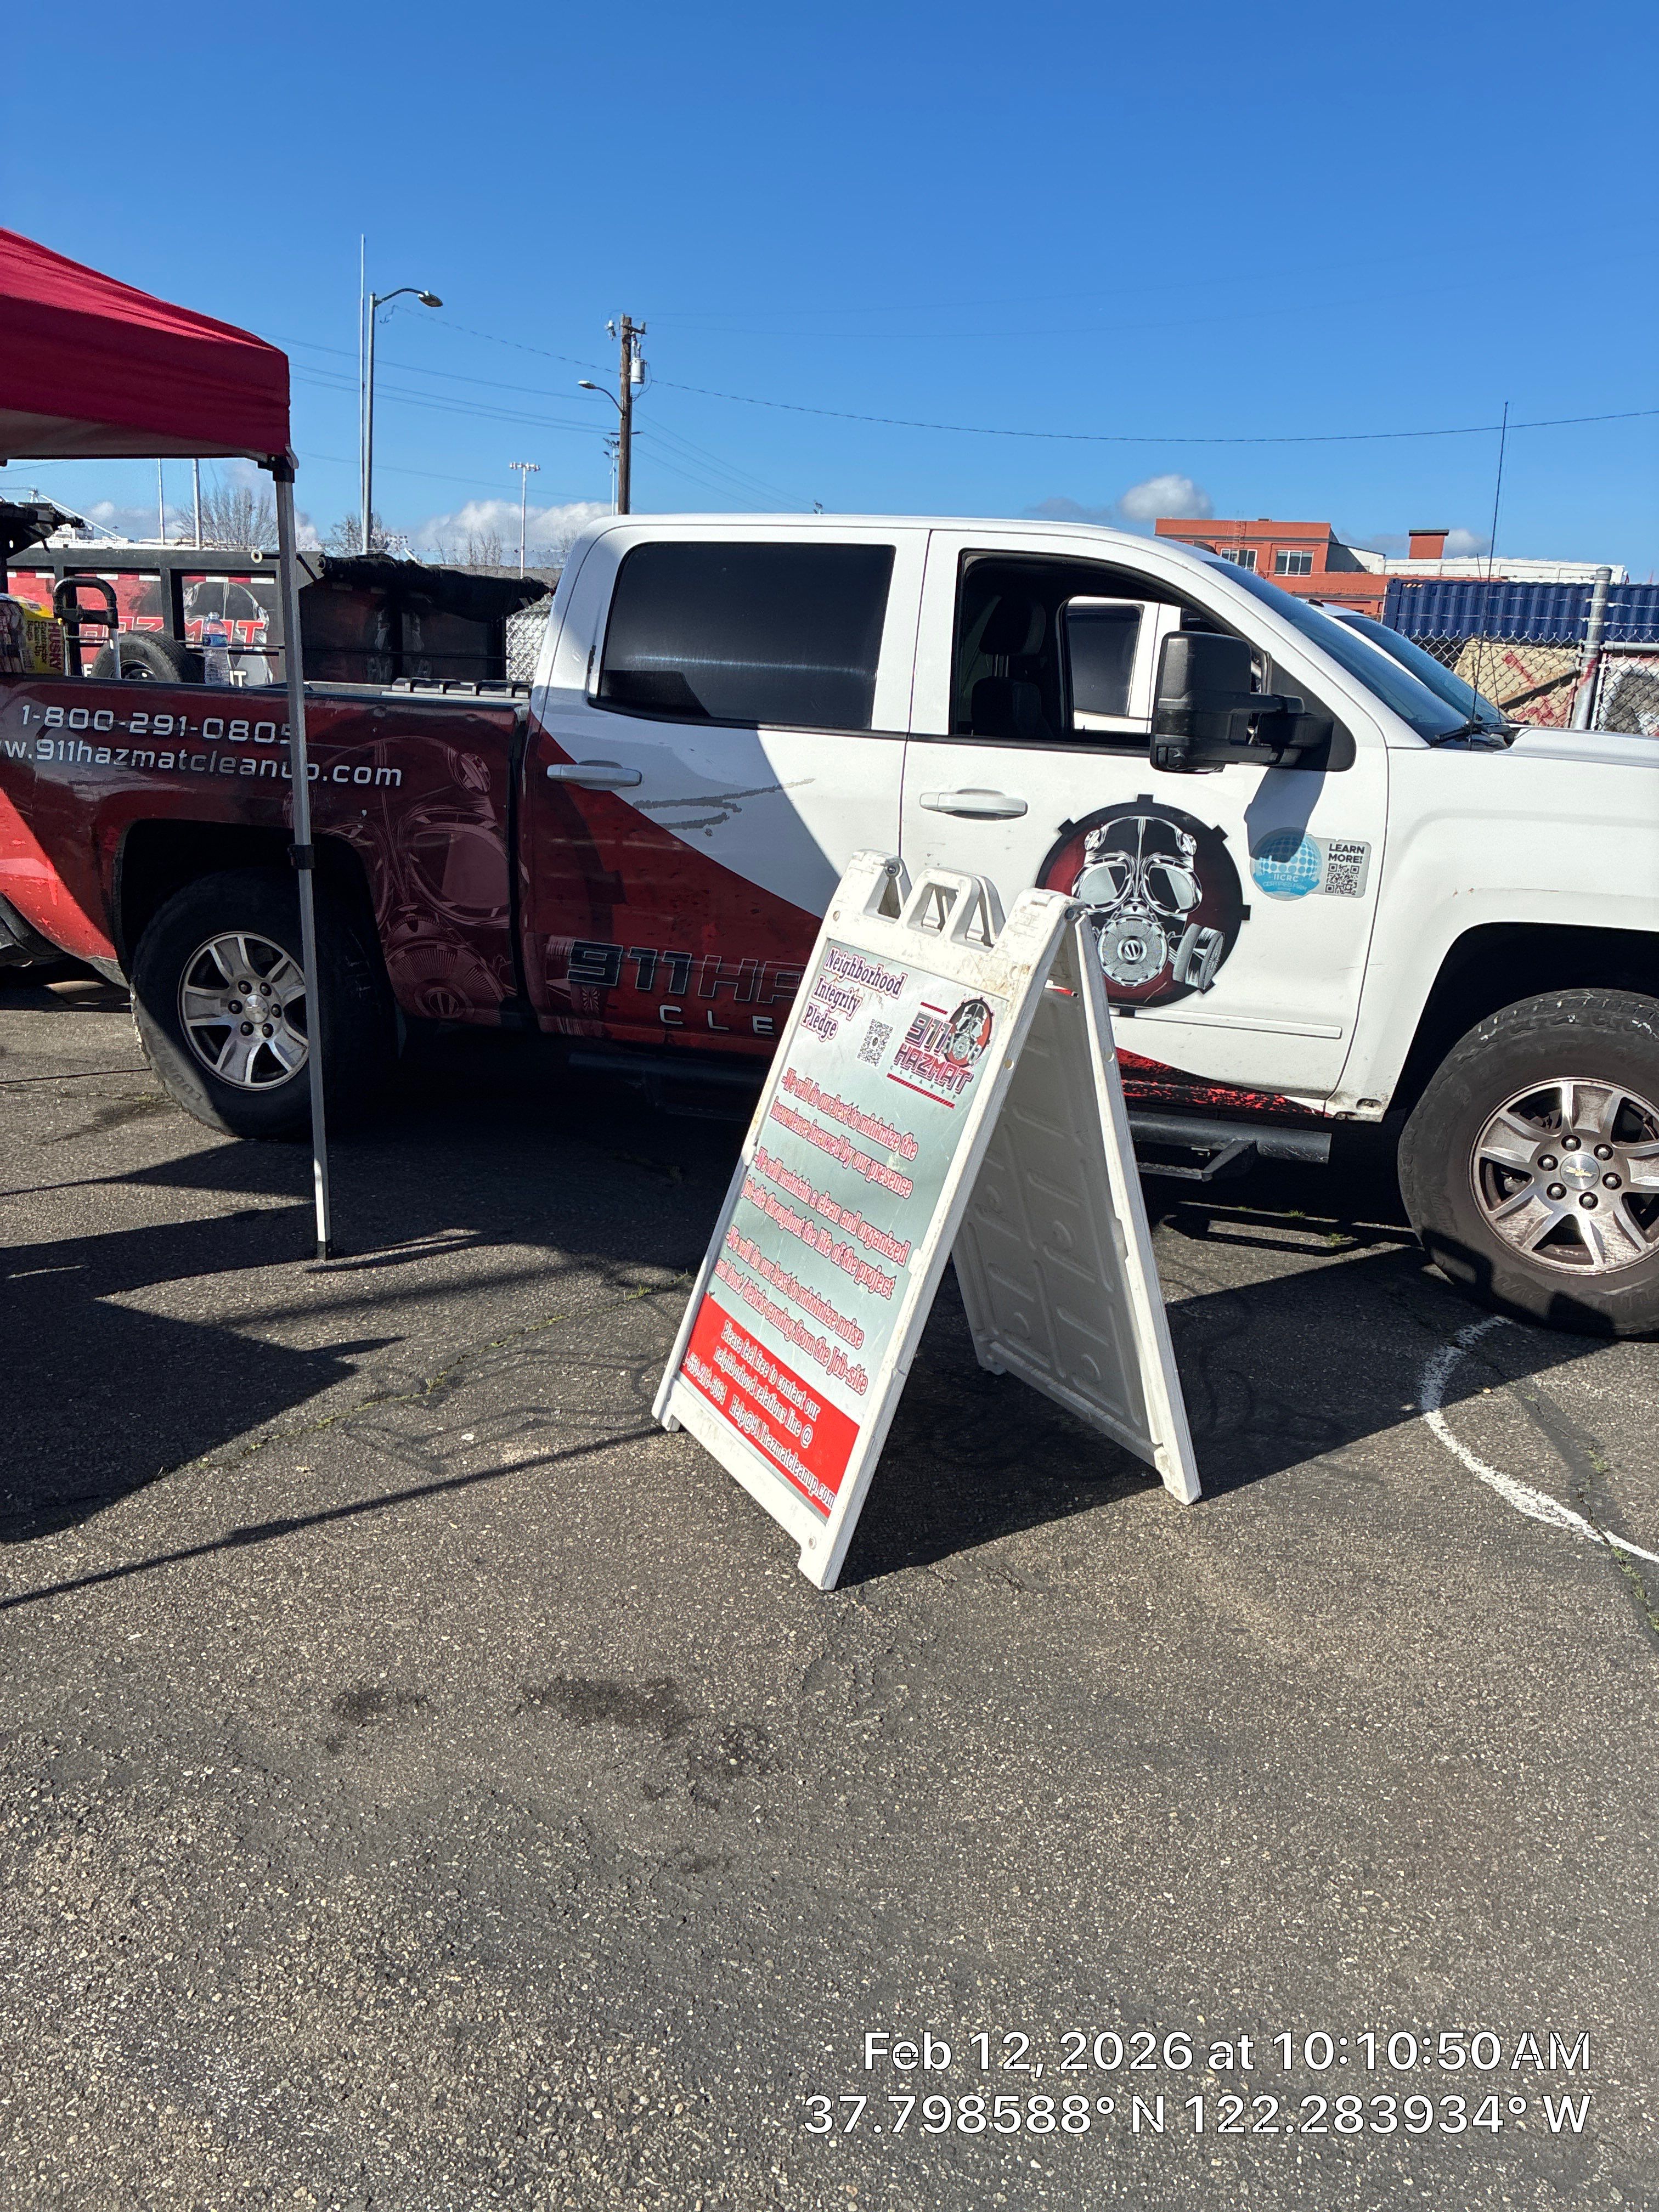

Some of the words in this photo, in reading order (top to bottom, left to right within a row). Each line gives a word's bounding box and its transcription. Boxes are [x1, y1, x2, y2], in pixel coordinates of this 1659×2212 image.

[48, 622, 63, 670] HUSKY
[0, 738, 403, 786] w.911hazmatcleanup.com
[1328, 853, 1363, 864] MORE!
[1329, 843, 1365, 855] LEARN
[1273, 873, 1300, 882] IICRC
[814, 975, 862, 1019] Integrity
[824, 946, 907, 997] Neighborhood
[800, 1004, 837, 1039] Pledge
[905, 1011, 953, 1056] 911
[894, 1043, 975, 1094] HAZMAT
[782, 1068, 797, 1092] -We
[793, 1077, 812, 1101] will
[807, 1083, 820, 1106] do
[817, 1093, 835, 1114] our
[829, 1094, 853, 1124] best
[847, 1105, 861, 1129] to
[857, 1115, 901, 1152] minimize
[898, 1132, 918, 1161] the
[806, 1122, 845, 1158] incurred
[838, 1137, 856, 1169] by
[852, 1151, 871, 1175] our
[865, 1159, 913, 1199] presence
[753, 1147, 768, 1171] -We
[764, 1158, 783, 1182] will
[777, 1168, 812, 1204] maintain
[809, 1190, 819, 1209] a
[815, 1191, 842, 1224] clean
[838, 1209, 862, 1236] and
[856, 1221, 910, 1266] organized
[741, 1178, 767, 1208] job-site
[764, 1193, 806, 1238] throughout
[801, 1219, 819, 1247] the
[814, 1227, 833, 1257] life
[830, 1242, 846, 1266] of
[840, 1246, 859, 1275] the
[854, 1261, 895, 1299] project
[725, 1224, 740, 1249] -We
[736, 1238, 754, 1263] will
[749, 1245, 762, 1268] do
[759, 1257, 775, 1278] our
[770, 1261, 792, 1292] best
[787, 1276, 800, 1300] to
[796, 1287, 839, 1328] minimize
[836, 1316, 864, 1348] noise
[714, 1257, 729, 1280] and
[764, 1302, 797, 1339] coming
[792, 1321, 816, 1352] from
[812, 1336, 831, 1366] the
[827, 1347, 867, 1395] Job-site
[713, 1346, 758, 1395] neighborhood
[753, 1384, 787, 1424] relations
[784, 1407, 802, 1437] line
[720, 1319, 743, 1353] Please
[740, 1338, 757, 1366] feel
[753, 1350, 770, 1378] free
[768, 1364, 777, 1385] to
[776, 1374, 806, 1409] contact
[804, 1398, 821, 1421] our
